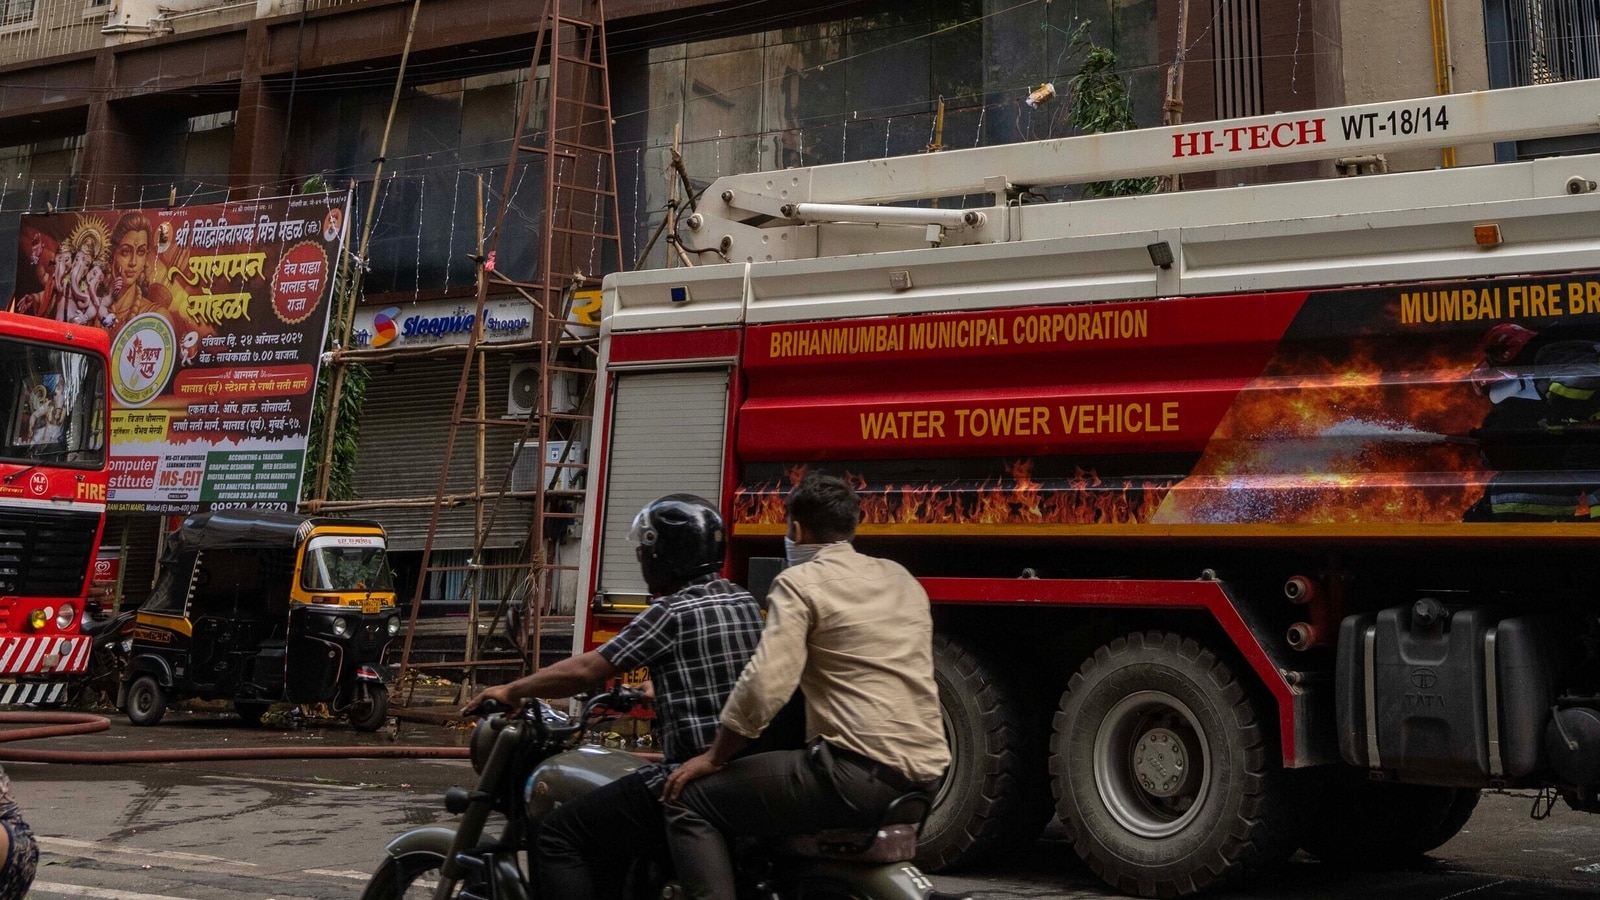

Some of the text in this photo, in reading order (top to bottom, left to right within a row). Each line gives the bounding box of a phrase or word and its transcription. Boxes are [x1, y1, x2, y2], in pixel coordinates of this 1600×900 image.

[1341, 105, 1449, 141] WT-18/14
[1172, 118, 1326, 157] HI-TECH
[176, 220, 190, 248] श्री
[257, 215, 277, 244] मित्र
[287, 298, 307, 312] राजा
[1401, 281, 1600, 324] MUMBAI FIRE BR
[401, 309, 528, 337] Sleepwel Shoppe
[240, 334, 253, 346] २४
[255, 331, 279, 345] ऑगस्ट
[281, 331, 303, 345] २०२५
[770, 309, 1149, 358] BRIHANMUMBAI MUNICIPAL CORPORATION
[233, 370, 259, 379] आगमन
[860, 401, 1180, 440] WATER TOWER VEHICLE
[108, 458, 157, 474] omputer
[108, 474, 154, 487] stitute
[159, 470, 203, 486] MS-CIT
[78, 482, 106, 501] FIRE
[1404, 693, 1446, 708] TATA
